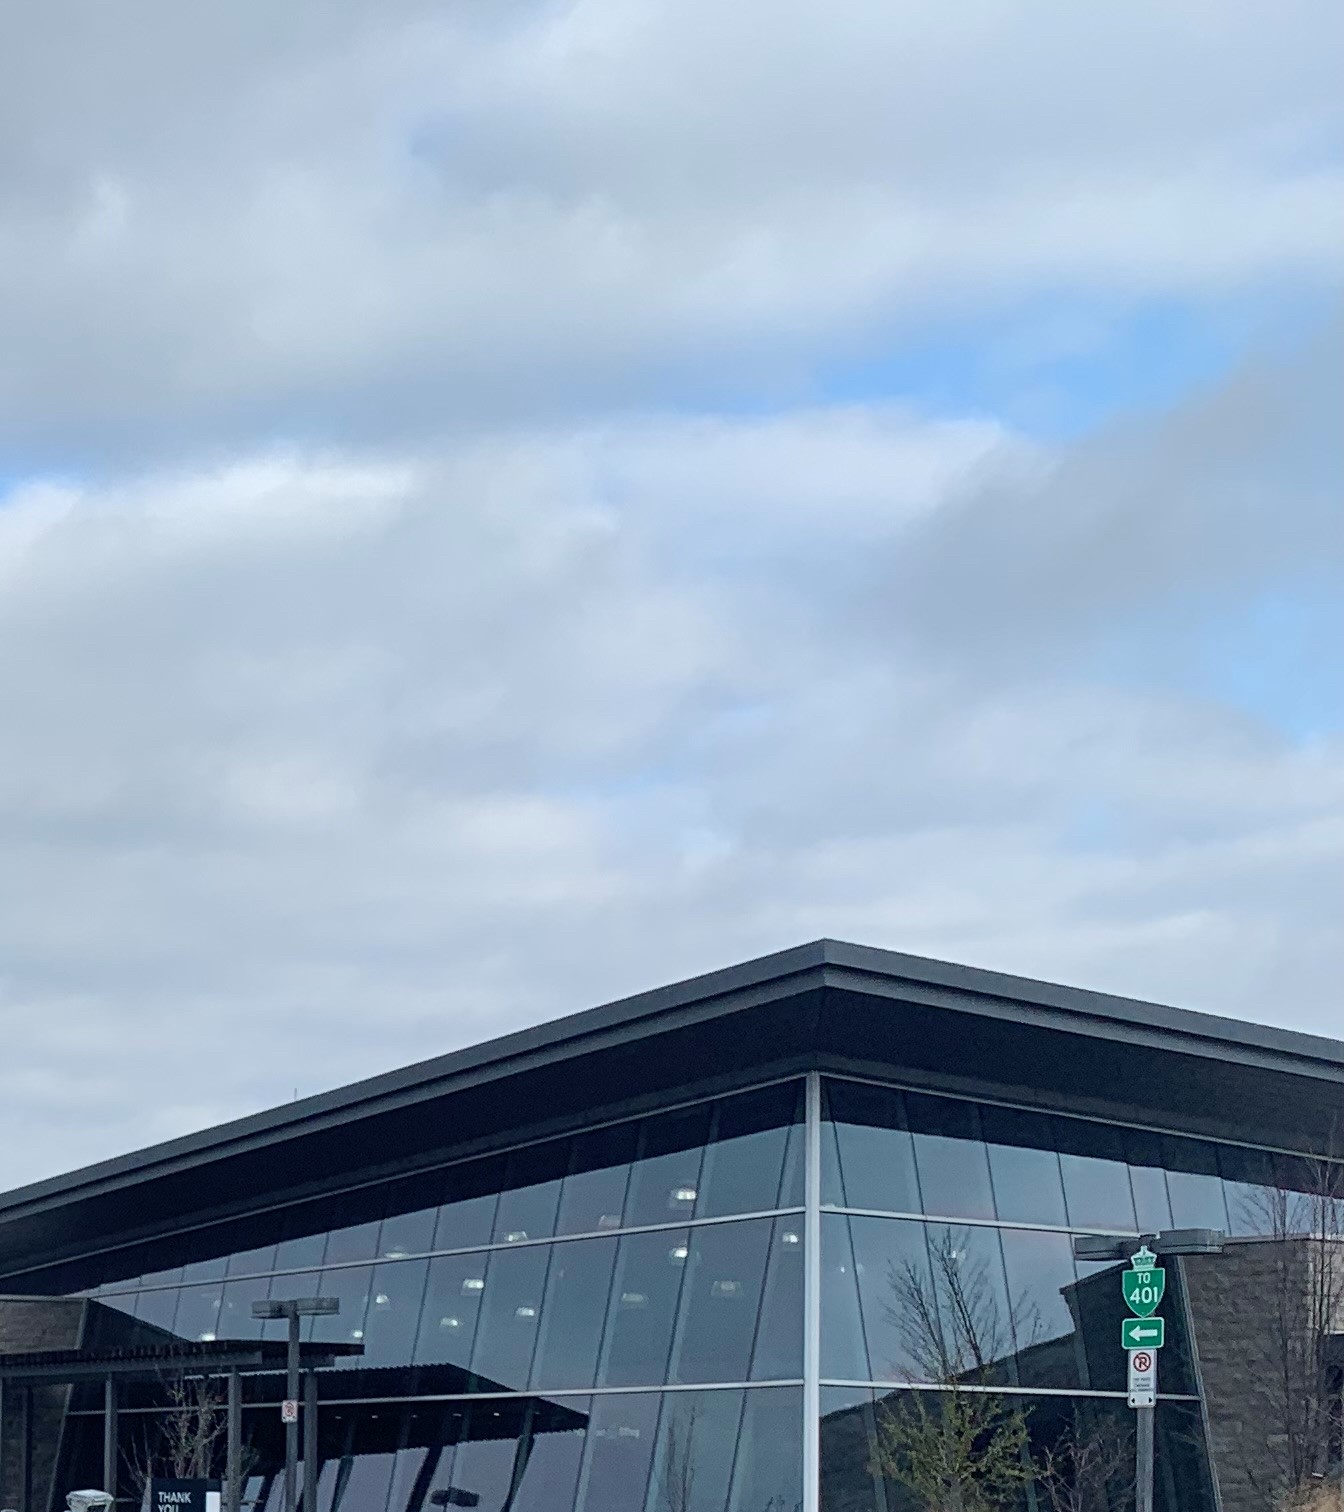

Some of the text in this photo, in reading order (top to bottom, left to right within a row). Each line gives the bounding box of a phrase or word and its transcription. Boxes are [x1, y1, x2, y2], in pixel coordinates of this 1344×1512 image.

[1137, 1273, 1151, 1284] TO
[1129, 1286, 1158, 1304] 401
[158, 1491, 192, 1503] THANK
